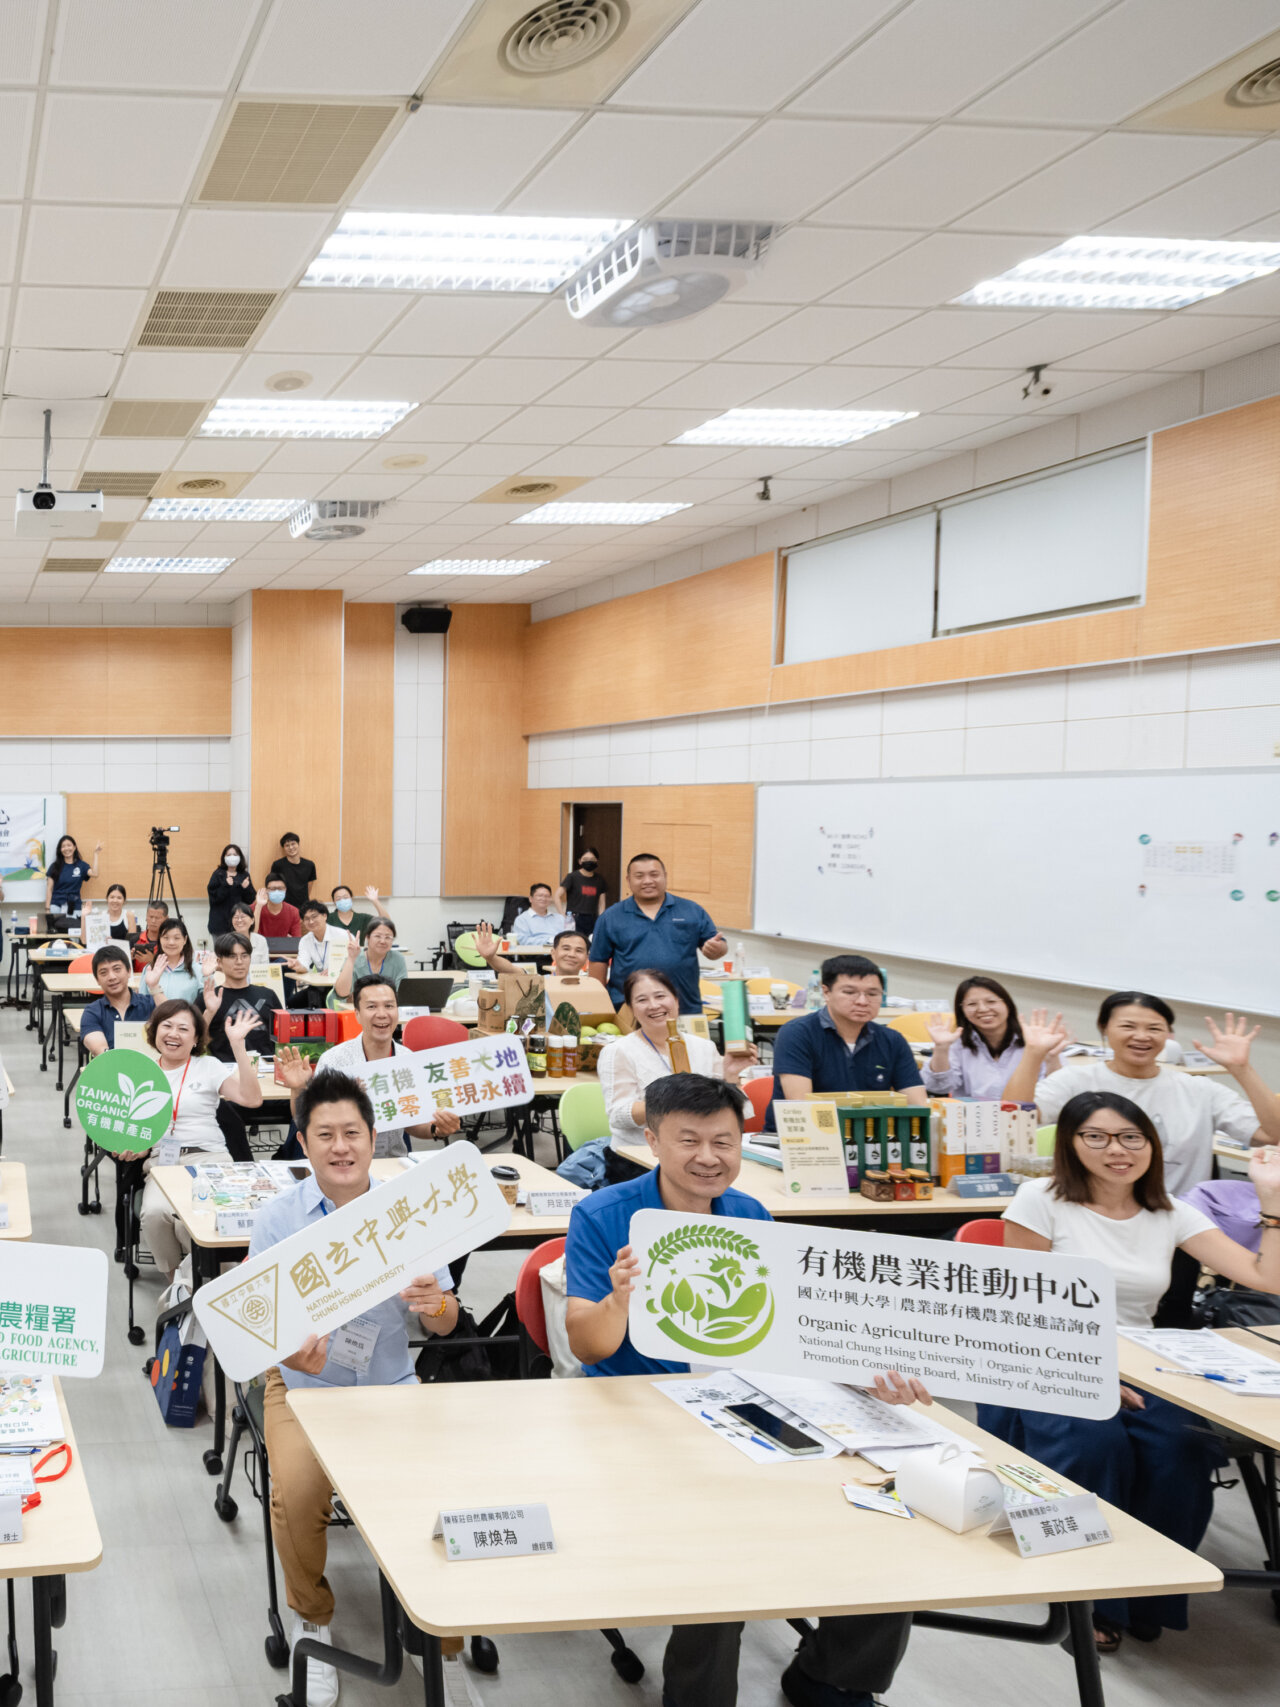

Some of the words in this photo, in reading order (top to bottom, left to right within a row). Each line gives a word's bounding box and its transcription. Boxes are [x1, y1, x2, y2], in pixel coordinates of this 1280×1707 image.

[368, 1068, 415, 1095] 有機
[423, 1047, 520, 1083] 友善大地
[76, 1098, 128, 1118] ORGANIC
[80, 1085, 130, 1107] TAIWAN
[375, 1095, 421, 1121] 淨零
[431, 1073, 527, 1110] 實現永續
[87, 1113, 152, 1141] 有機農產品
[289, 1162, 478, 1299] 國立中興大學
[306, 1287, 345, 1312] NATIONAL
[311, 1305, 339, 1322] CHUNG
[339, 1288, 363, 1309] HSING
[362, 1263, 406, 1294] UNIVERSITY
[797, 1245, 1101, 1310] 有機農業推動中心
[797, 1285, 891, 1310] 國立中興大學
[900, 1296, 1101, 1336] 農業部有機農業促進諮詢會
[10, 1333, 43, 1347] FOOD
[48, 1337, 99, 1354] AGENCY,
[797, 1314, 857, 1336] Organic
[861, 1321, 951, 1346] Agriculture
[954, 1334, 1041, 1357] Promotion
[1045, 1345, 1102, 1366] Center
[799, 1334, 843, 1350] National
[845, 1339, 882, 1356] Chung
[884, 1345, 916, 1361] Hsing
[919, 1348, 976, 1368] University
[986, 1359, 1031, 1376] Organic
[1034, 1366, 1104, 1385] Agriculture
[803, 1350, 859, 1366] Promotion
[862, 1357, 921, 1377] Consulting
[924, 1366, 960, 1382] Board,
[966, 1372, 1014, 1392] Ministry
[1016, 1378, 1028, 1390] of
[1031, 1382, 1100, 1400] Agriculture
[3, 1532, 19, 1542] 技士
[1040, 1516, 1079, 1538] 黃政華
